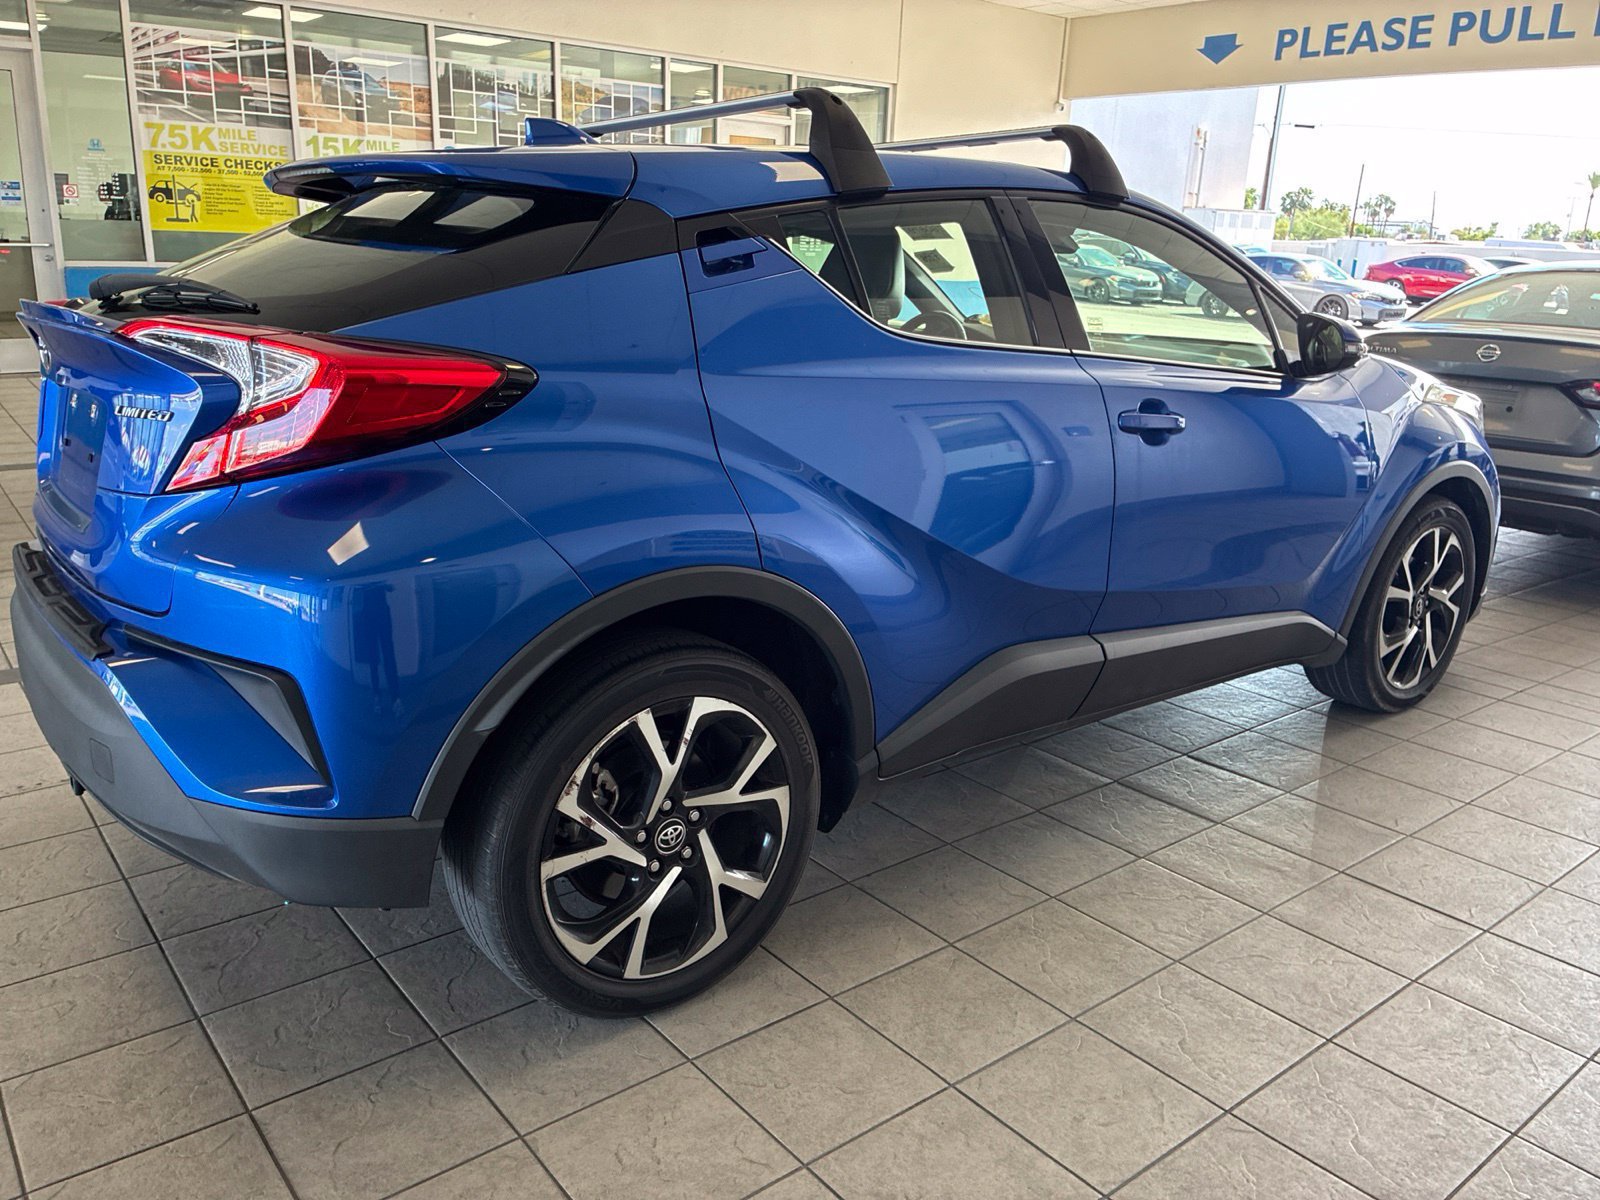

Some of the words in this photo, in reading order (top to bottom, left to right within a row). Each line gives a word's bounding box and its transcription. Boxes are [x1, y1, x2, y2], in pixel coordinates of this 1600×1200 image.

[1274, 14, 1435, 61] PLEASE
[1448, 3, 1577, 47] PULL
[144, 122, 218, 151] 7.5K
[218, 127, 257, 141] MILE
[218, 141, 289, 157] SERVICE
[306, 135, 365, 158] 15K
[366, 140, 401, 152] MILE
[153, 153, 219, 168] SERVICE
[114, 405, 172, 421] LIMITED
